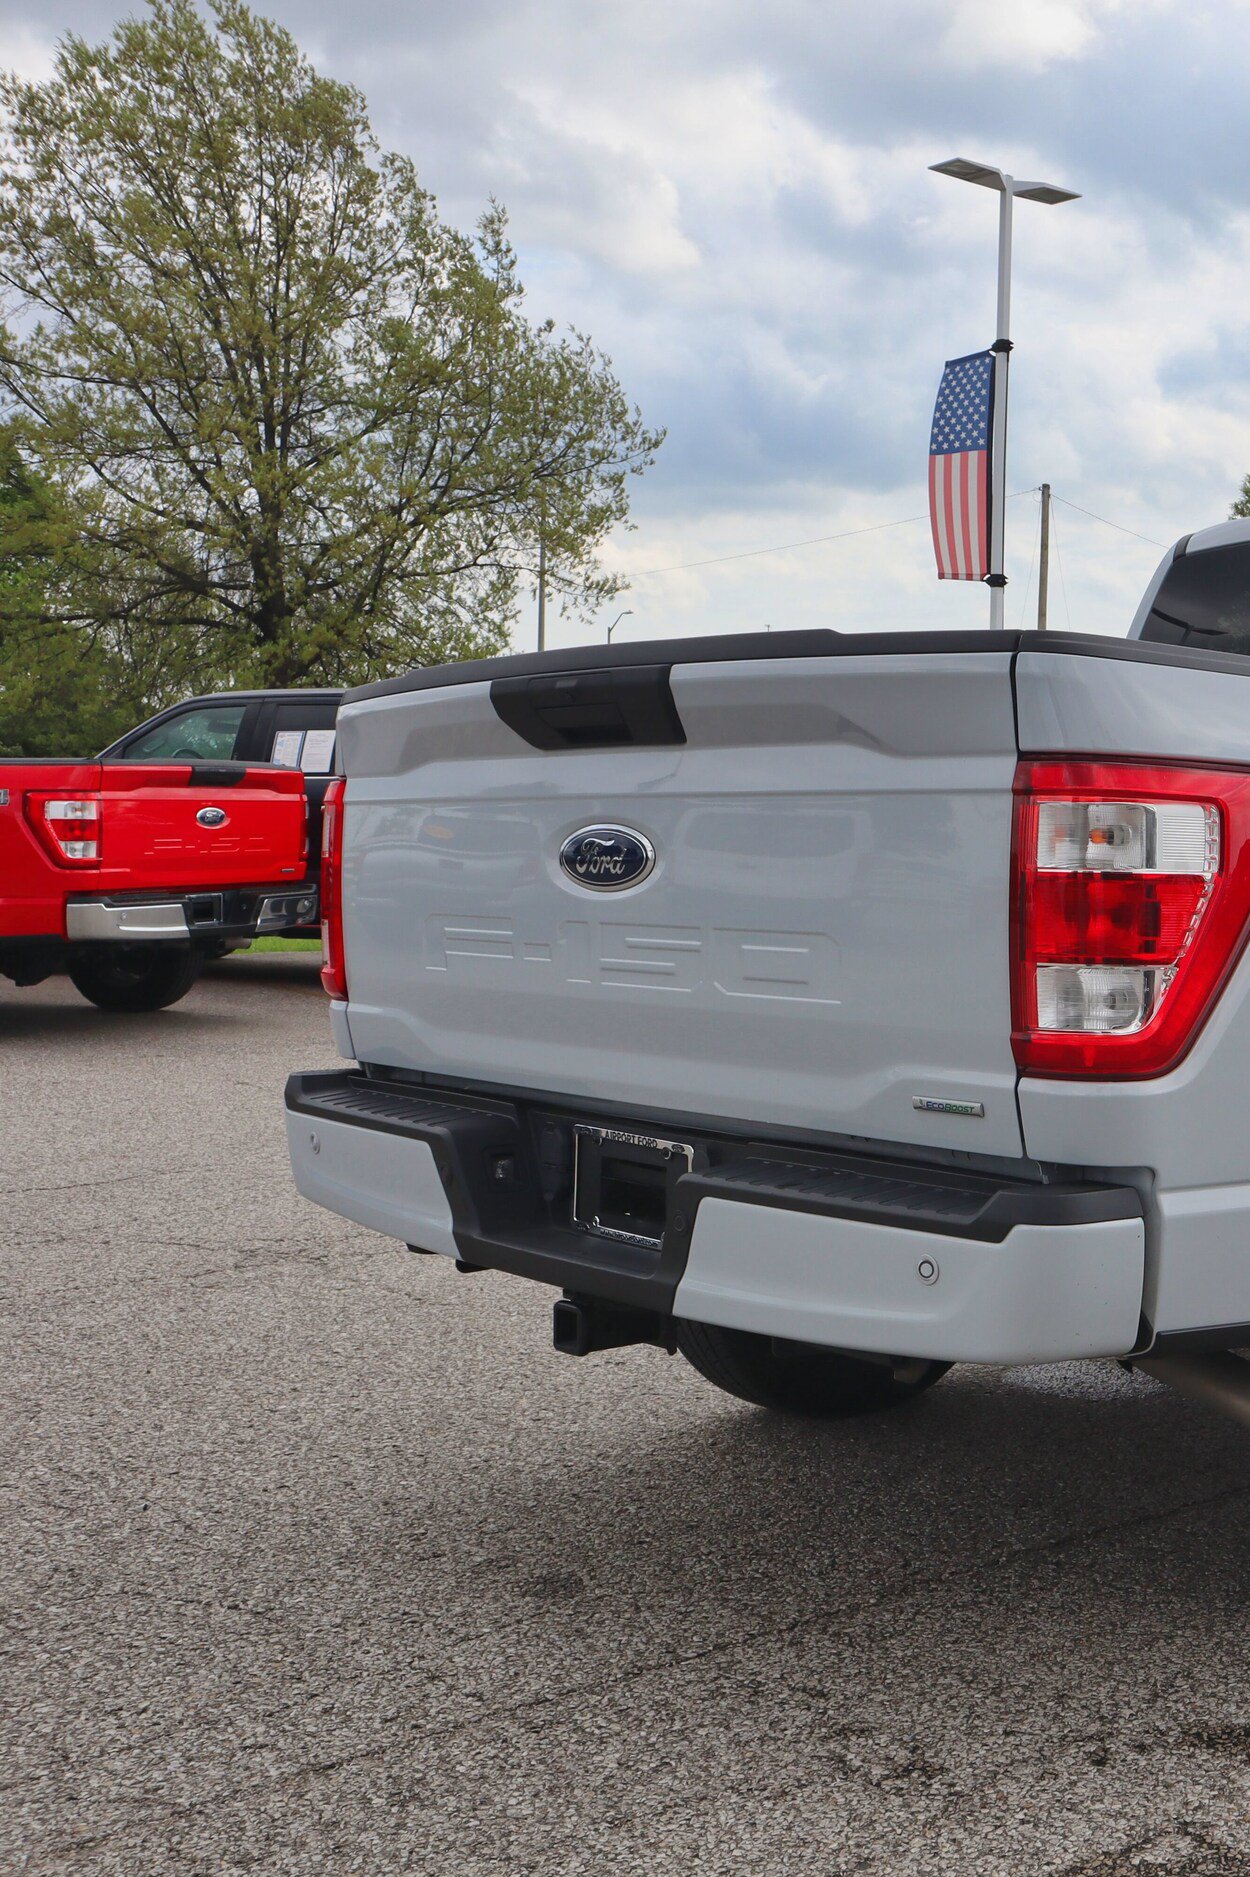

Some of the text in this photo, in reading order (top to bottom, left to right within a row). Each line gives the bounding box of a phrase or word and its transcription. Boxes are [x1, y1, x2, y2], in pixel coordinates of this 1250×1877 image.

[575, 837, 628, 875] Ford
[423, 912, 842, 1004] F-150
[605, 1130, 636, 1145] AIRPORT
[637, 1136, 658, 1149] FORD
